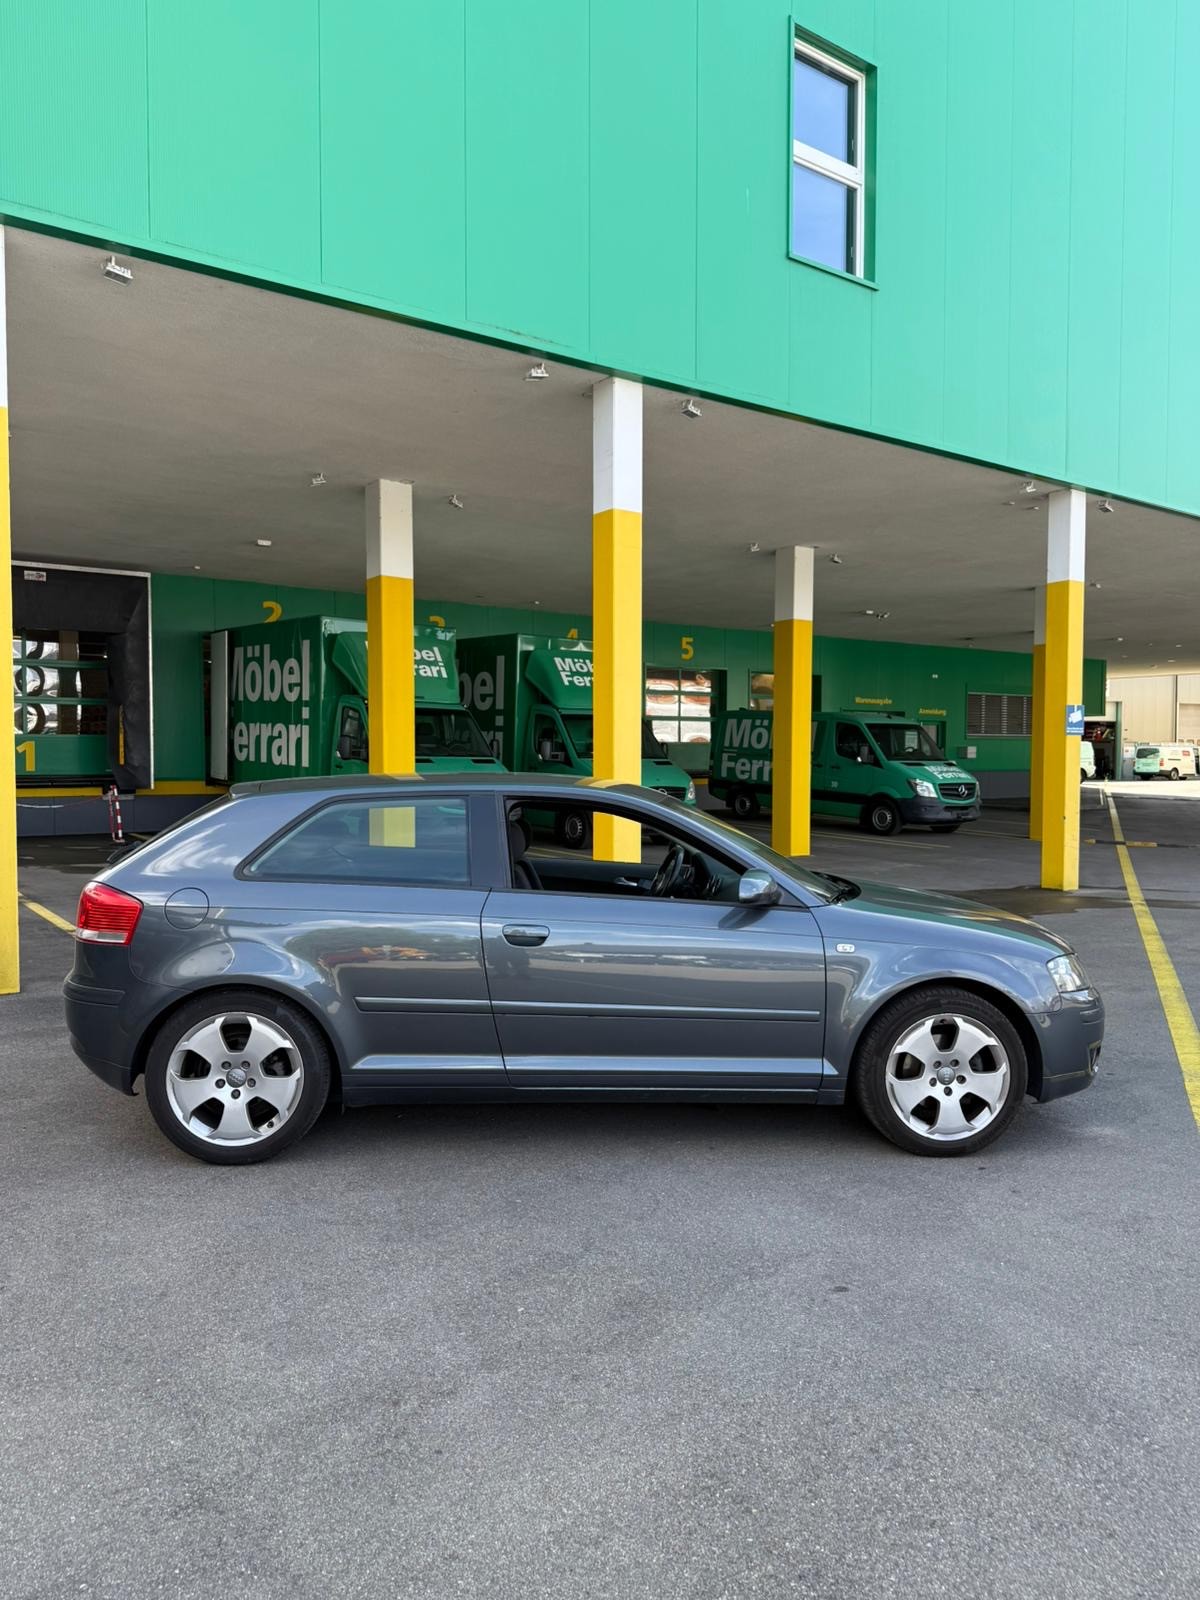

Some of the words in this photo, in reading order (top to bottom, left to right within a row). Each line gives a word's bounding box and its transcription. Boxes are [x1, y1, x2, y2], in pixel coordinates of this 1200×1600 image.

[680, 636, 695, 660] 5
[233, 706, 310, 768] errari
[16, 741, 36, 772] 1
[720, 749, 773, 782] Ferr
